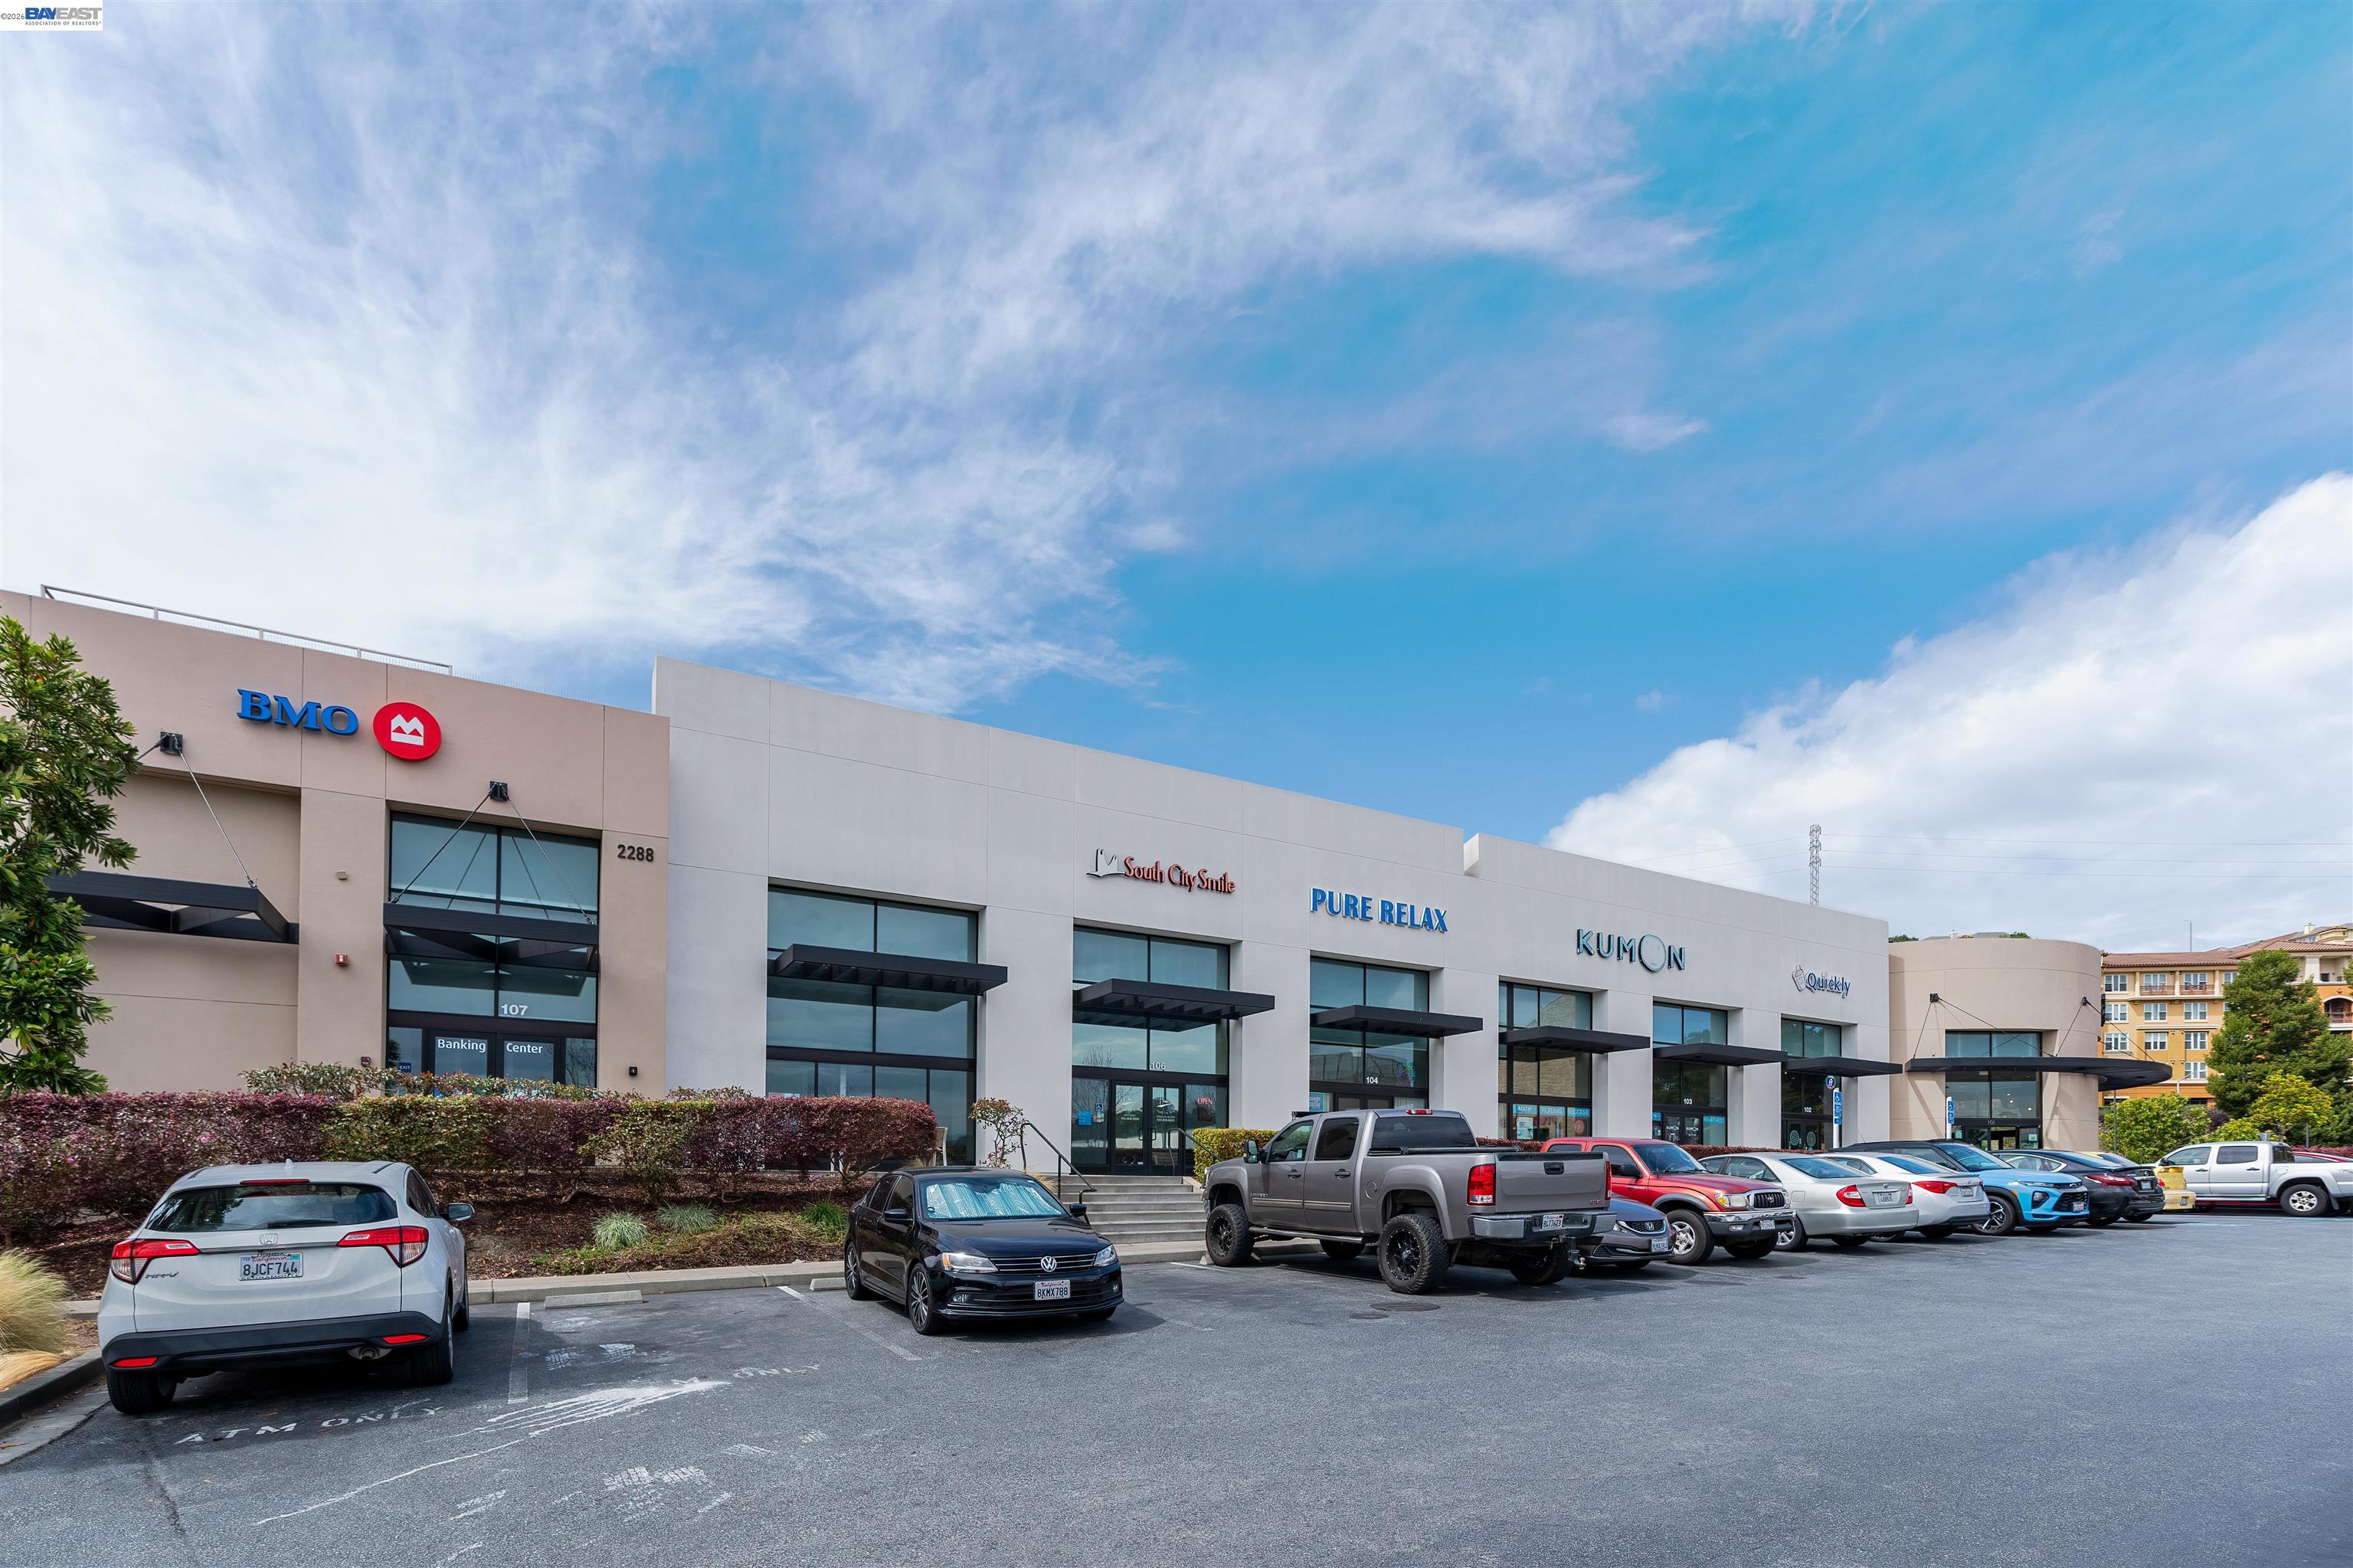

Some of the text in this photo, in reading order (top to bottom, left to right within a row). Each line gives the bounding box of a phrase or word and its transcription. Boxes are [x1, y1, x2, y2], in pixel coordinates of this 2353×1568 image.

[237, 689, 358, 735] BMO
[617, 843, 654, 863] 2288
[1124, 856, 1235, 893] South City Smile
[1311, 888, 1448, 933] PURE RELAX
[1576, 928, 1686, 973] KUMON
[1805, 972, 1851, 999] Quickly
[501, 1003, 528, 1016] 107
[437, 1039, 543, 1054] Banking Center
[1150, 1062, 1166, 1070] 106
[243, 1262, 298, 1275] 8JCF744
[1037, 1287, 1068, 1297] 8KMX788
[173, 1398, 444, 1445] ATM ONLY
